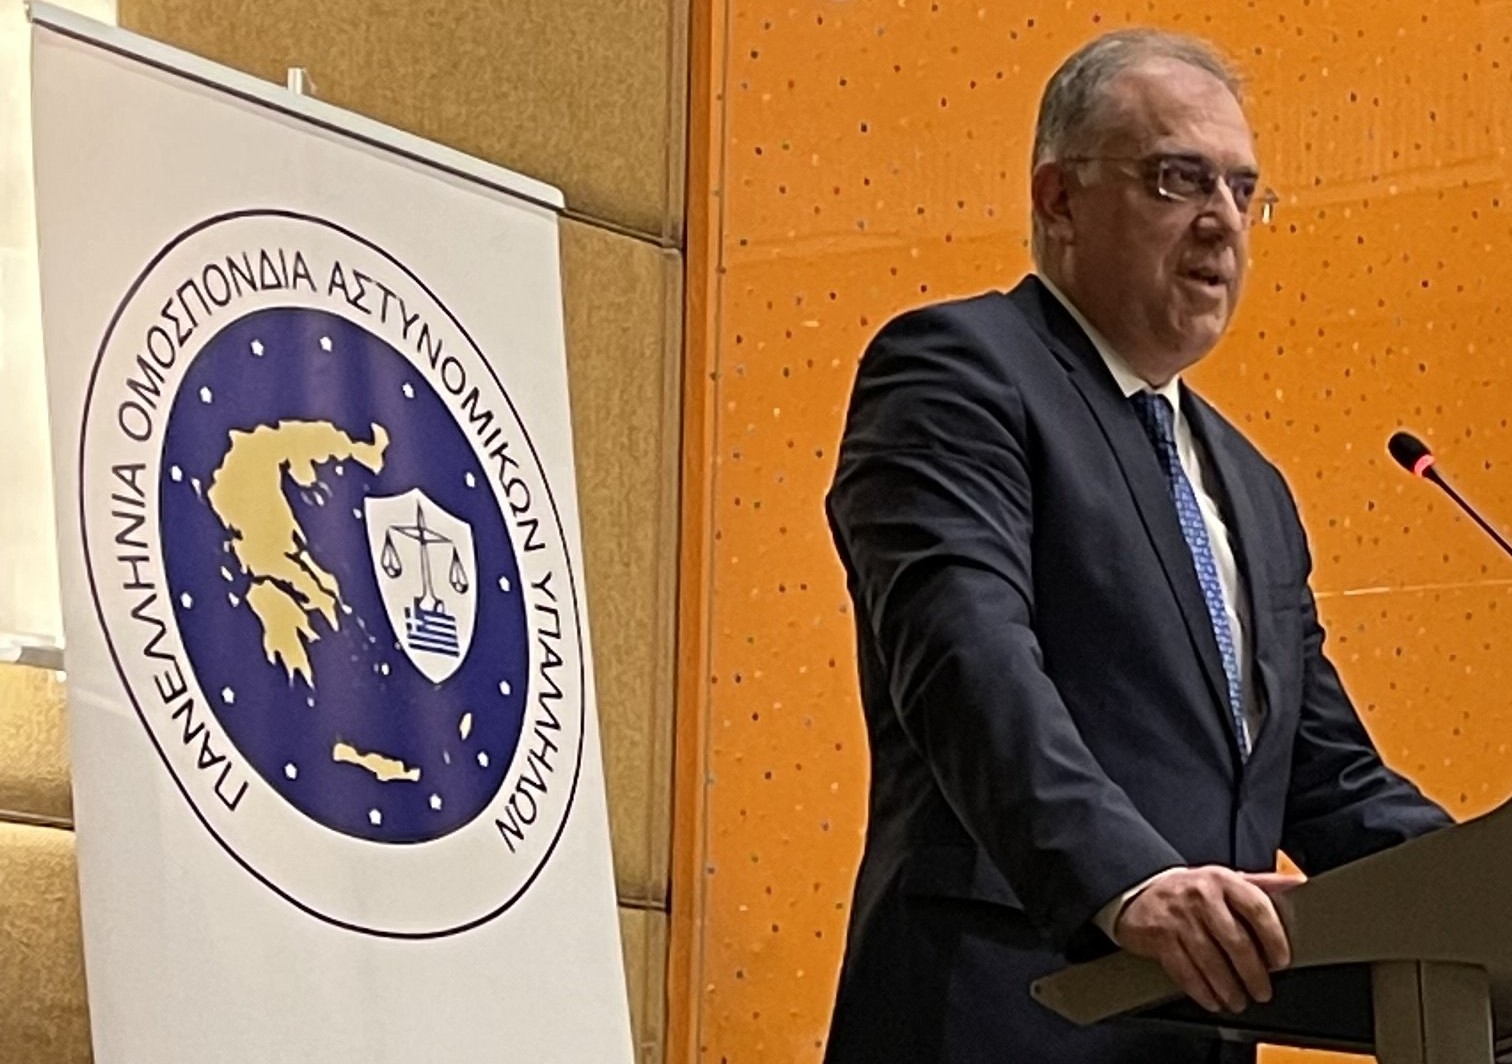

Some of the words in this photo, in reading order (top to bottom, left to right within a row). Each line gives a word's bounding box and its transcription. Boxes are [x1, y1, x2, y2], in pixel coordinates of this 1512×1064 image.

[118, 248, 317, 442] ΟΜΟΣΠΟΝΔΙΑ
[328, 260, 546, 553] ΑΣΤΥΝΟΜΙΚΩΝ
[111, 463, 250, 813] ΠΑΝΕΛΛΗΝΙΑ
[494, 571, 565, 854] ΥΠΑΛΛΗΛΩΝ
